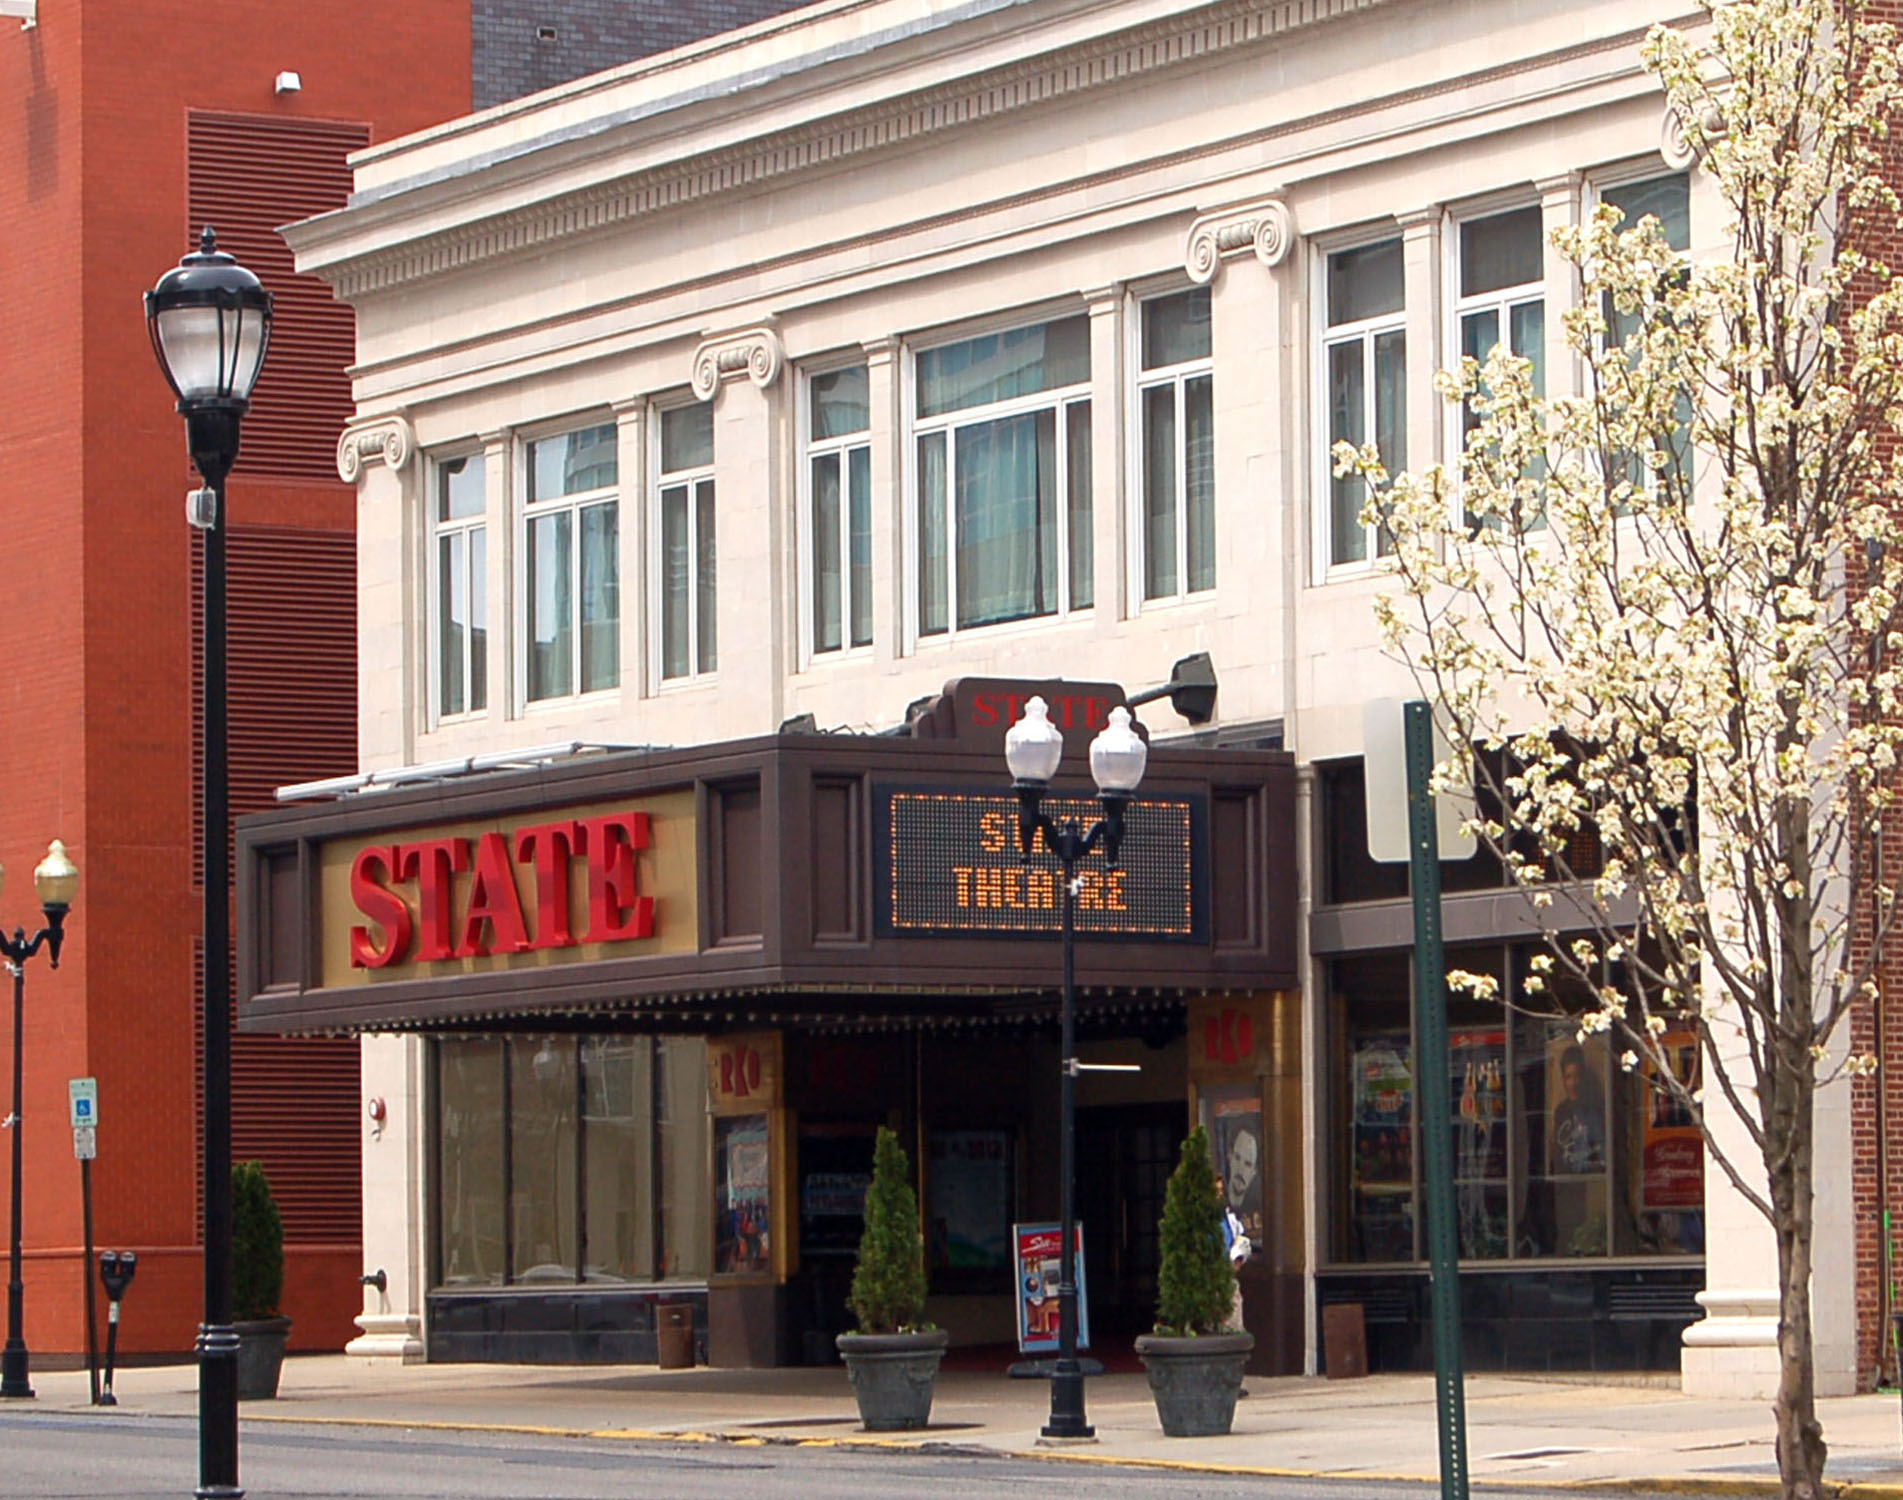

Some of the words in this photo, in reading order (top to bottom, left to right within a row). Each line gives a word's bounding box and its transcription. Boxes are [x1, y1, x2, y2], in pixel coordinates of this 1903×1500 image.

[972, 692, 1110, 730] STTE
[351, 811, 654, 968] STATE
[952, 867, 1127, 910] THEARE
[1205, 1008, 1253, 1064] RKO
[720, 1049, 760, 1097] RKO
